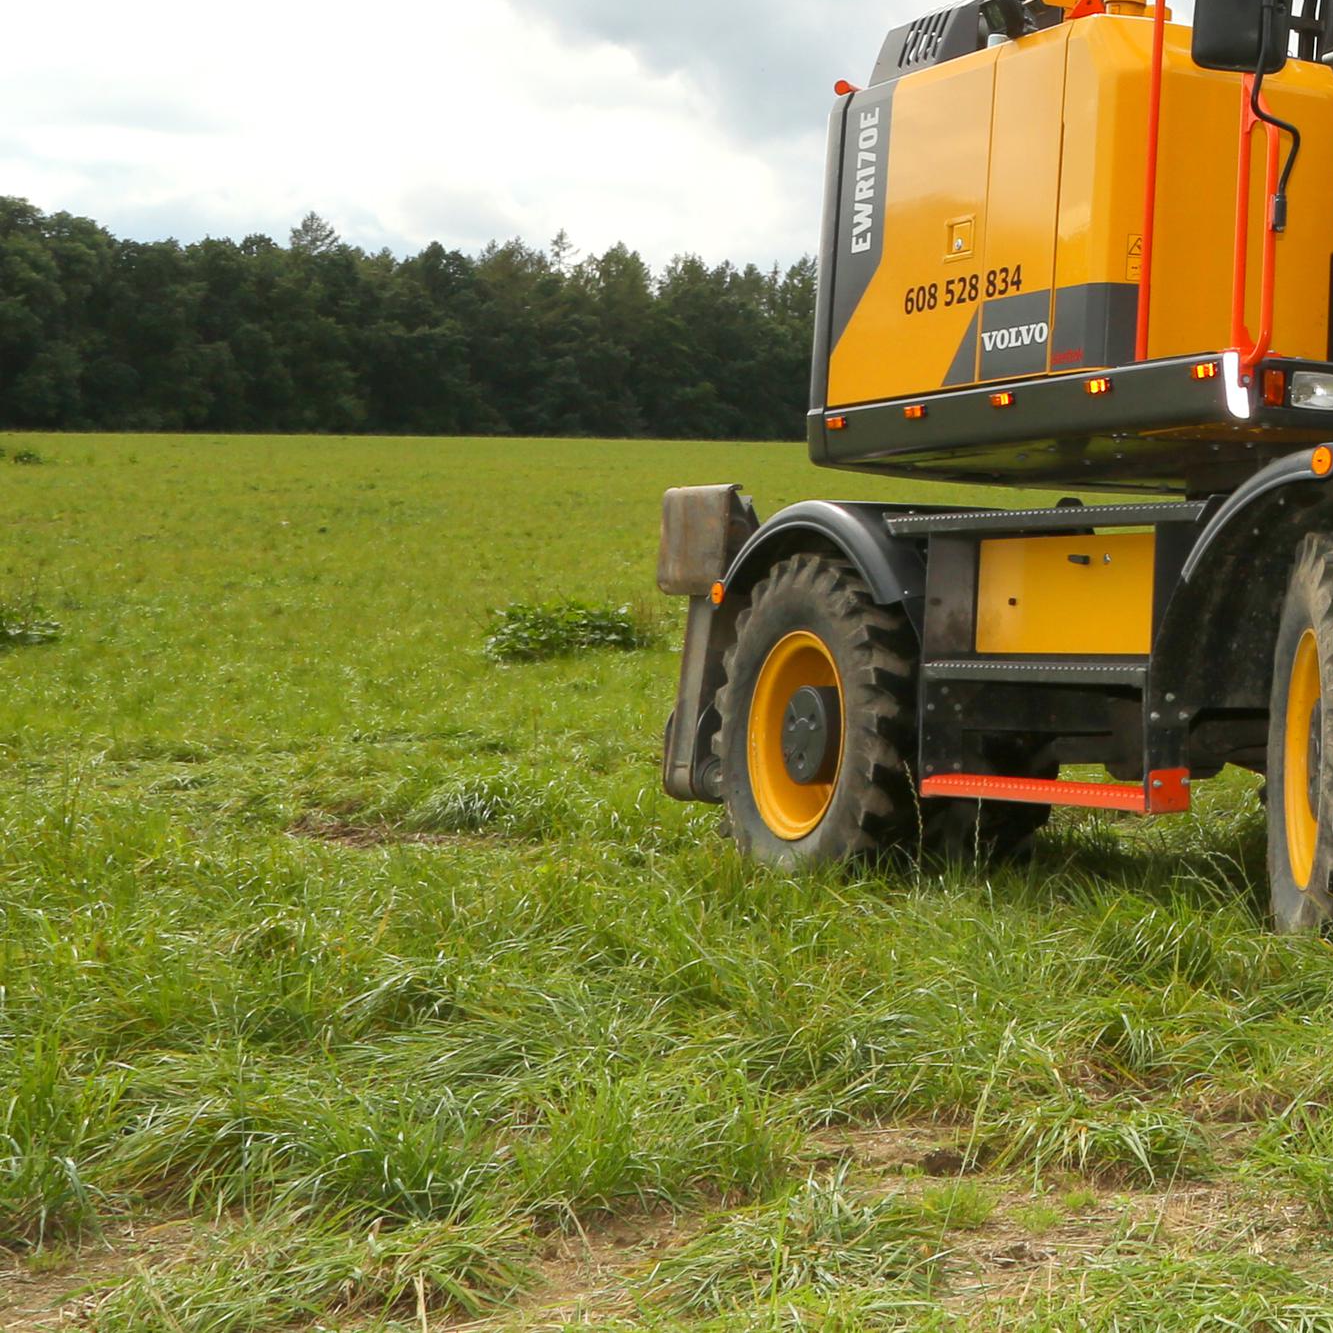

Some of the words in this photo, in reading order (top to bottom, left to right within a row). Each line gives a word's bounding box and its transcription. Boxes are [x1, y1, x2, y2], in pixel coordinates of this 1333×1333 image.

[851, 107, 880, 254] EWR170E
[904, 283, 938, 315] 608
[944, 274, 980, 307] 528
[985, 264, 1022, 298] 834
[981, 322, 1048, 352] VOLVO
